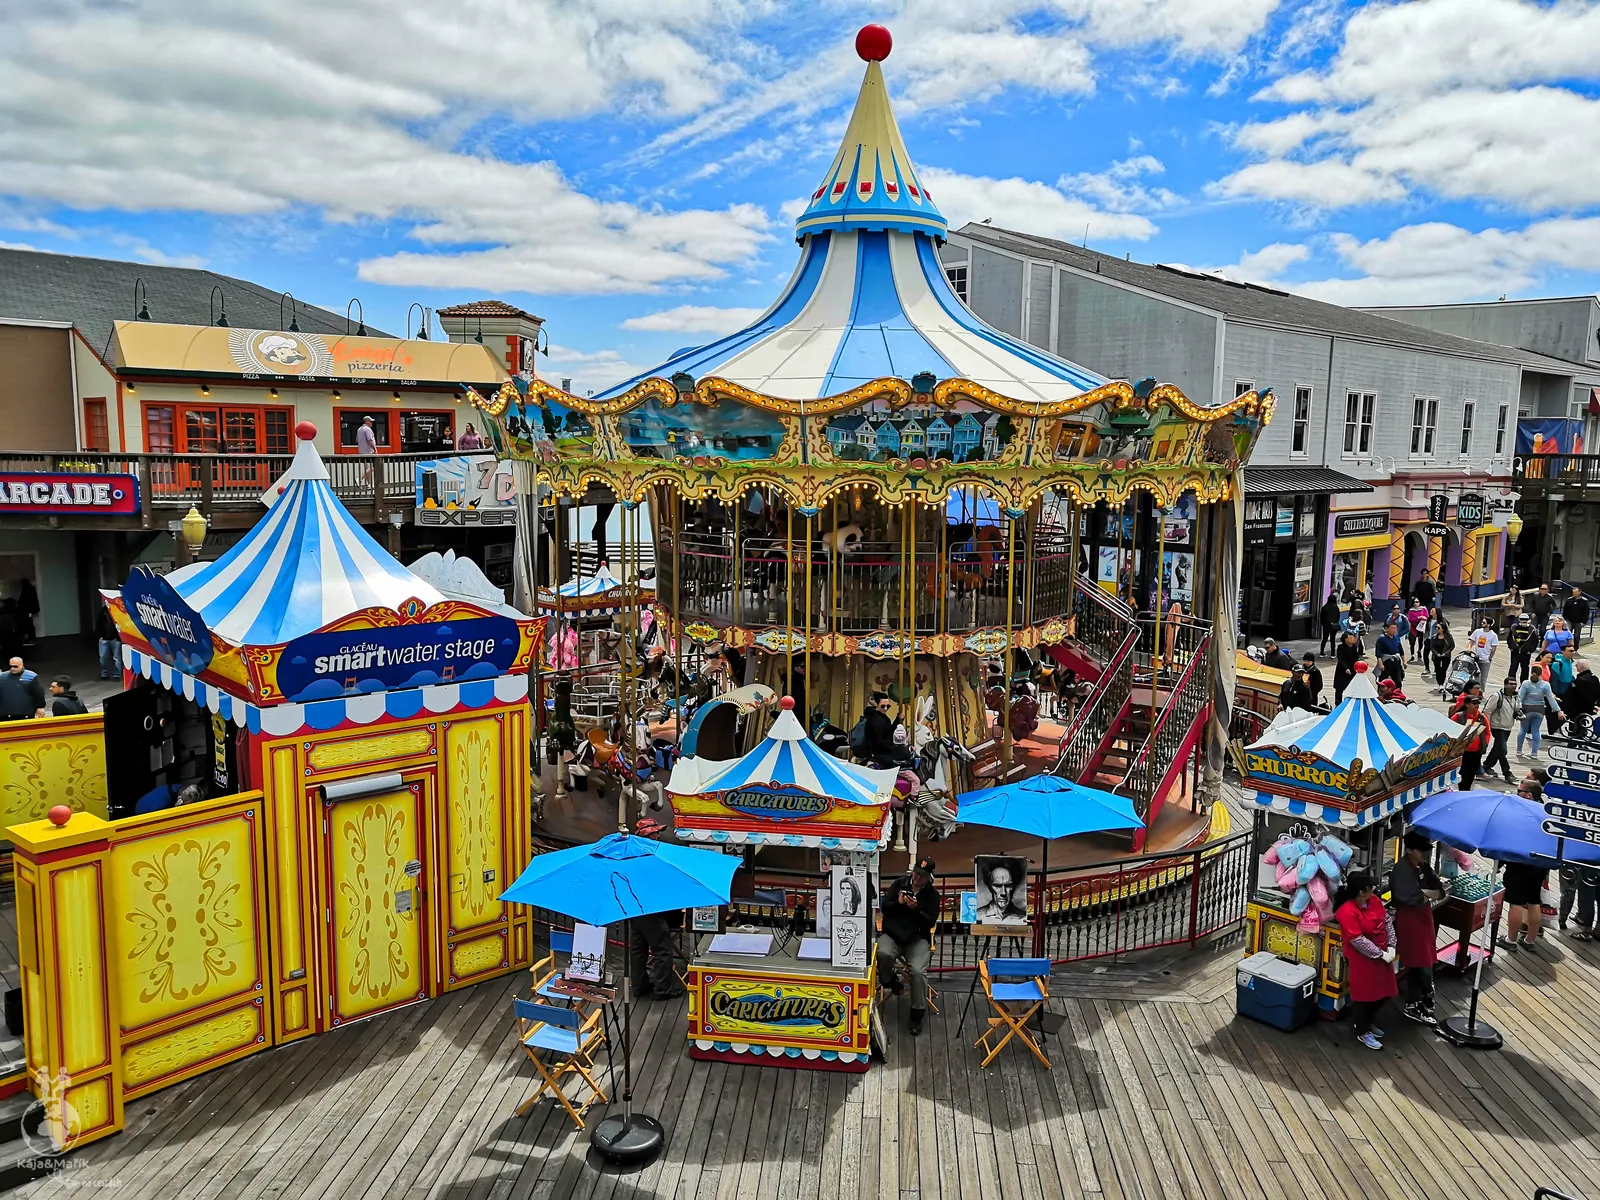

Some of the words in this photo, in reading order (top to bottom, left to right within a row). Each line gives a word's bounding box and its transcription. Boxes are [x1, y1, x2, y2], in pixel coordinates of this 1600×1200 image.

[328, 342, 412, 365] Luigi's
[347, 360, 404, 373] pizzeria
[1458, 505, 1481, 519] KIDS
[1424, 526, 1447, 535] KAPS
[136, 602, 197, 643] smartwater
[314, 642, 441, 674] smartwater
[444, 638, 495, 660] stage
[339, 642, 378, 655] GLACÉAU
[1403, 744, 1449, 771] CHURROS
[1245, 753, 1350, 791] CHURROS
[726, 791, 828, 812] CARICATURES
[711, 991, 846, 1027] CARICATURES
